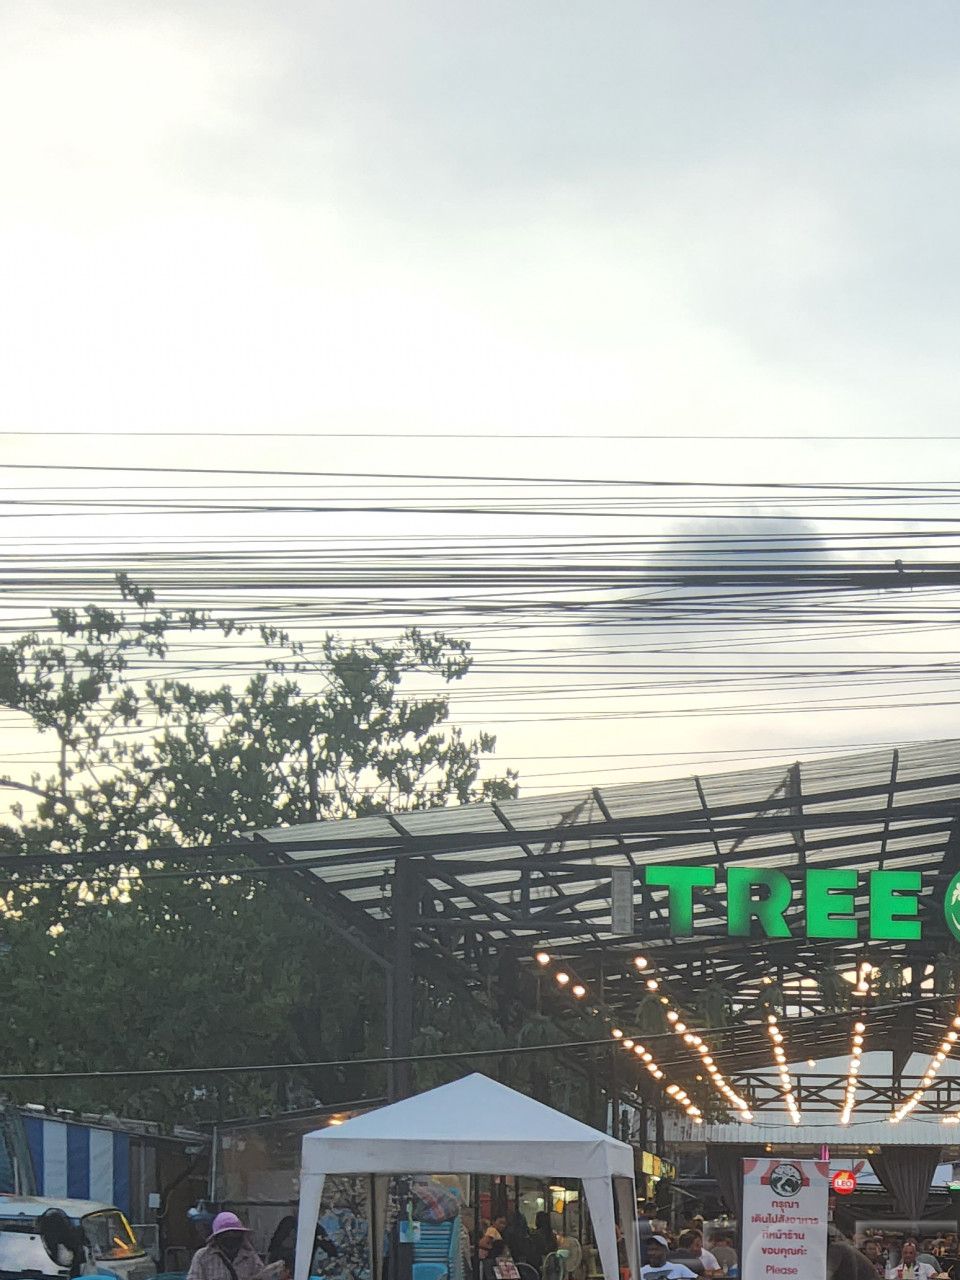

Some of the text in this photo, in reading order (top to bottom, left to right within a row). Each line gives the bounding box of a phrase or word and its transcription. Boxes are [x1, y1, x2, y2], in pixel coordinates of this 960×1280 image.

[645, 865, 922, 940] TREE
[836, 1180, 853, 1188] LEO
[765, 1265, 798, 1275] Please
